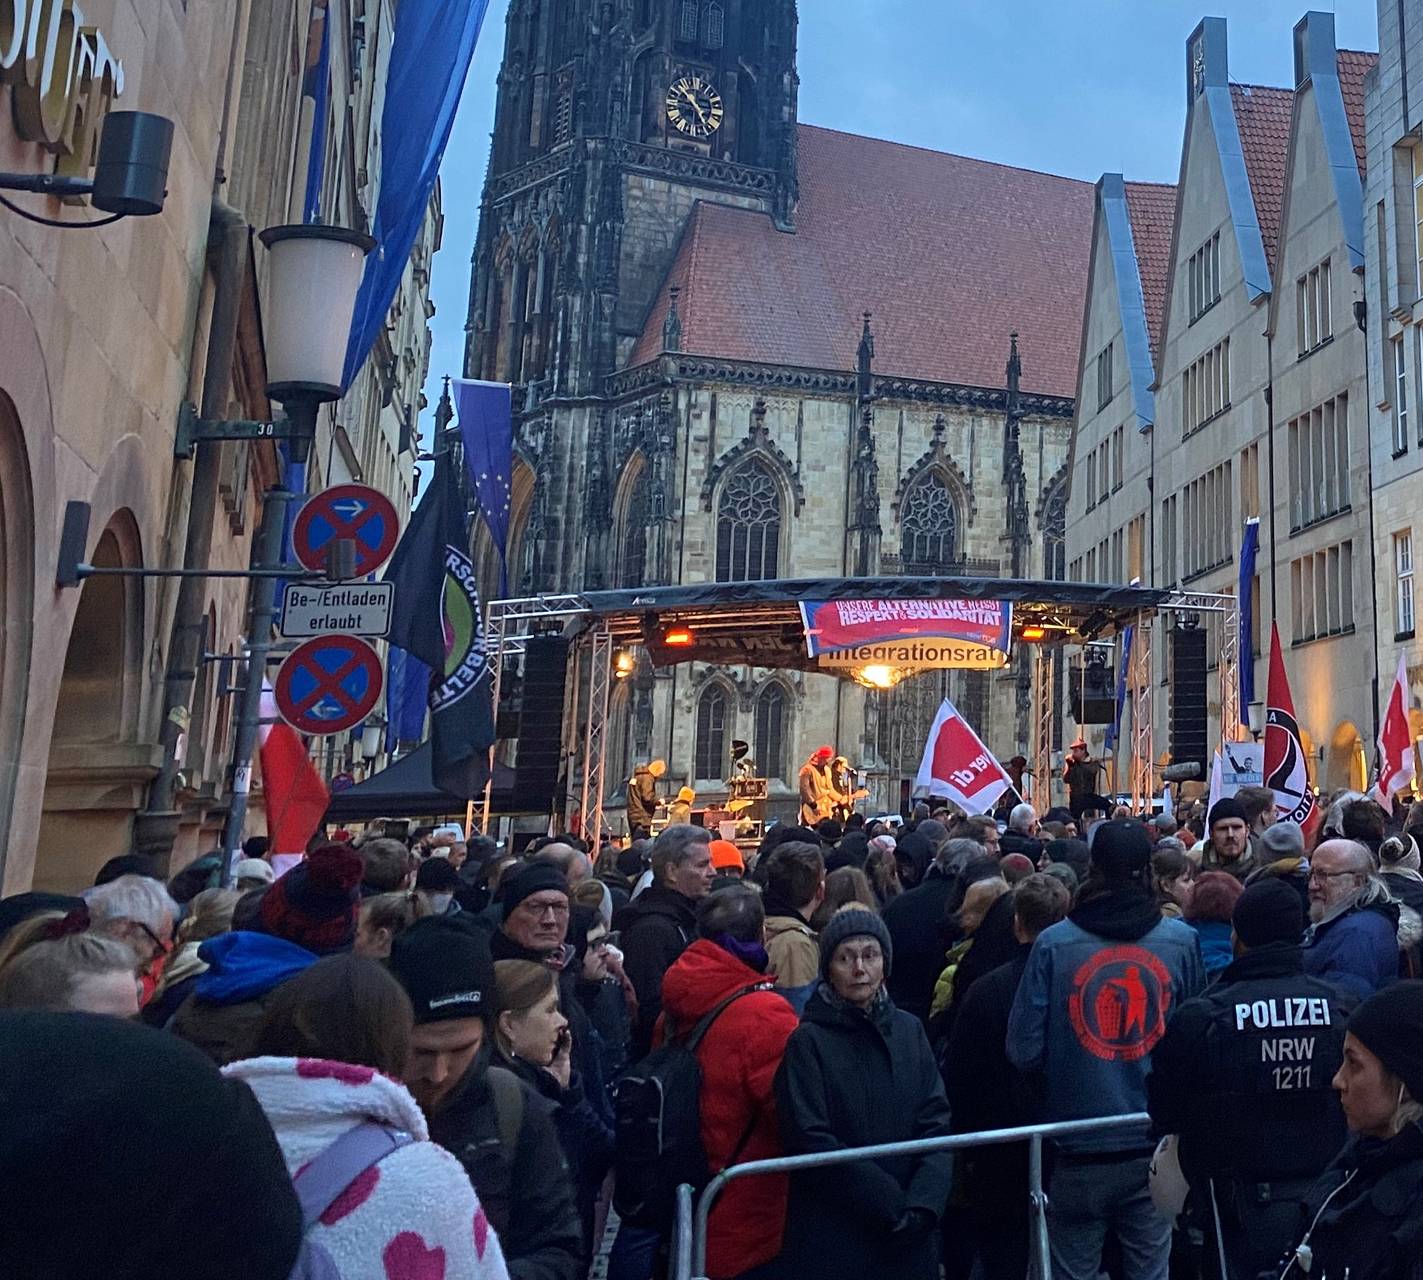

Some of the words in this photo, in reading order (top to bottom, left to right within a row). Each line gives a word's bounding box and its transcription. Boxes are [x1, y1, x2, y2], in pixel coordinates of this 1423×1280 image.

[257, 423, 273, 436] 30
[290, 590, 387, 608] Be-/Entladen
[878, 600, 968, 611] ALTERNATIVE
[309, 614, 362, 630] erlaubt
[838, 610, 900, 626] RESPEKT
[1235, 998, 1331, 1030] POLIZEI
[1261, 1037, 1315, 1062] NRW
[1272, 1066, 1311, 1090] 1211
